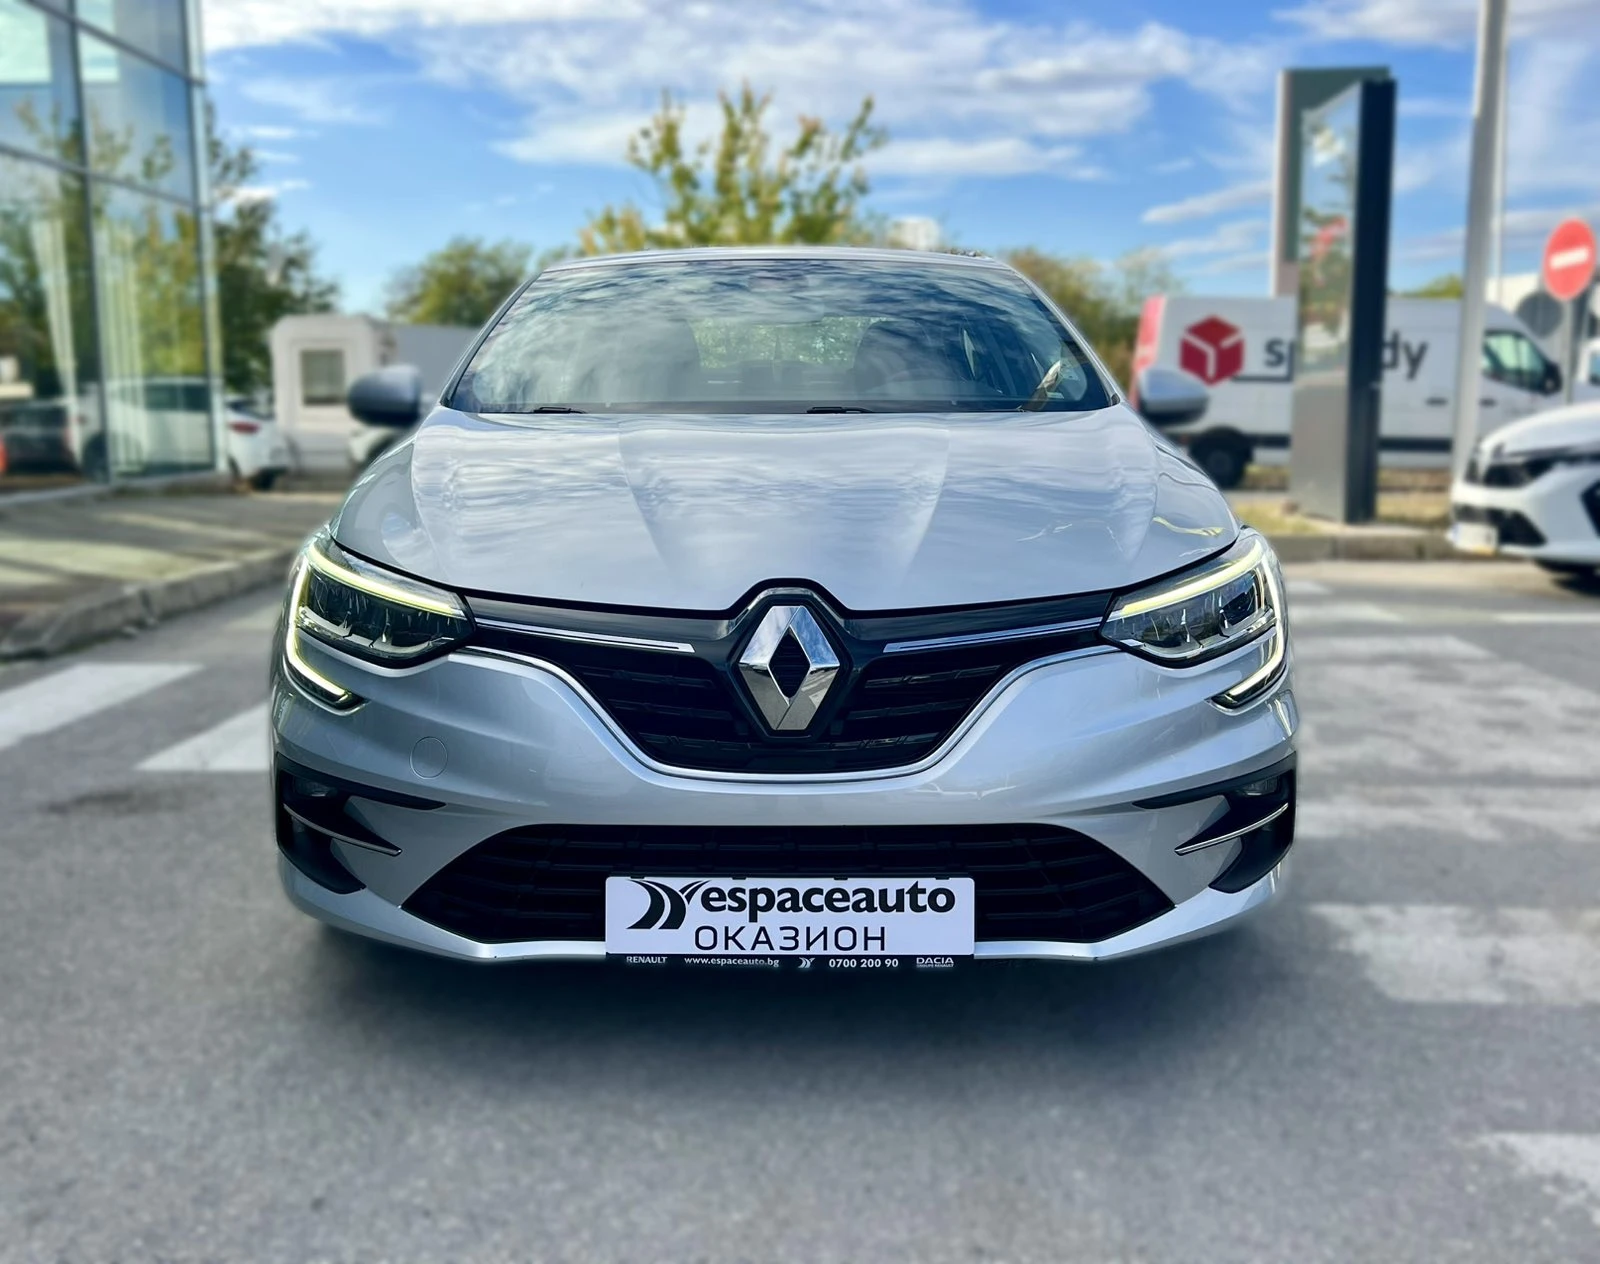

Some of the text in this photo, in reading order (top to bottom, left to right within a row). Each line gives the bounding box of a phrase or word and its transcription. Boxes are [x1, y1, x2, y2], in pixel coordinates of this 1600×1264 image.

[700, 880, 956, 923] espaceauto
[694, 926, 885, 951] ОКАЗИОН
[626, 956, 668, 964] RENAULT
[684, 957, 780, 968] www.espaceauto.bg
[828, 958, 899, 968] 0700 200 90
